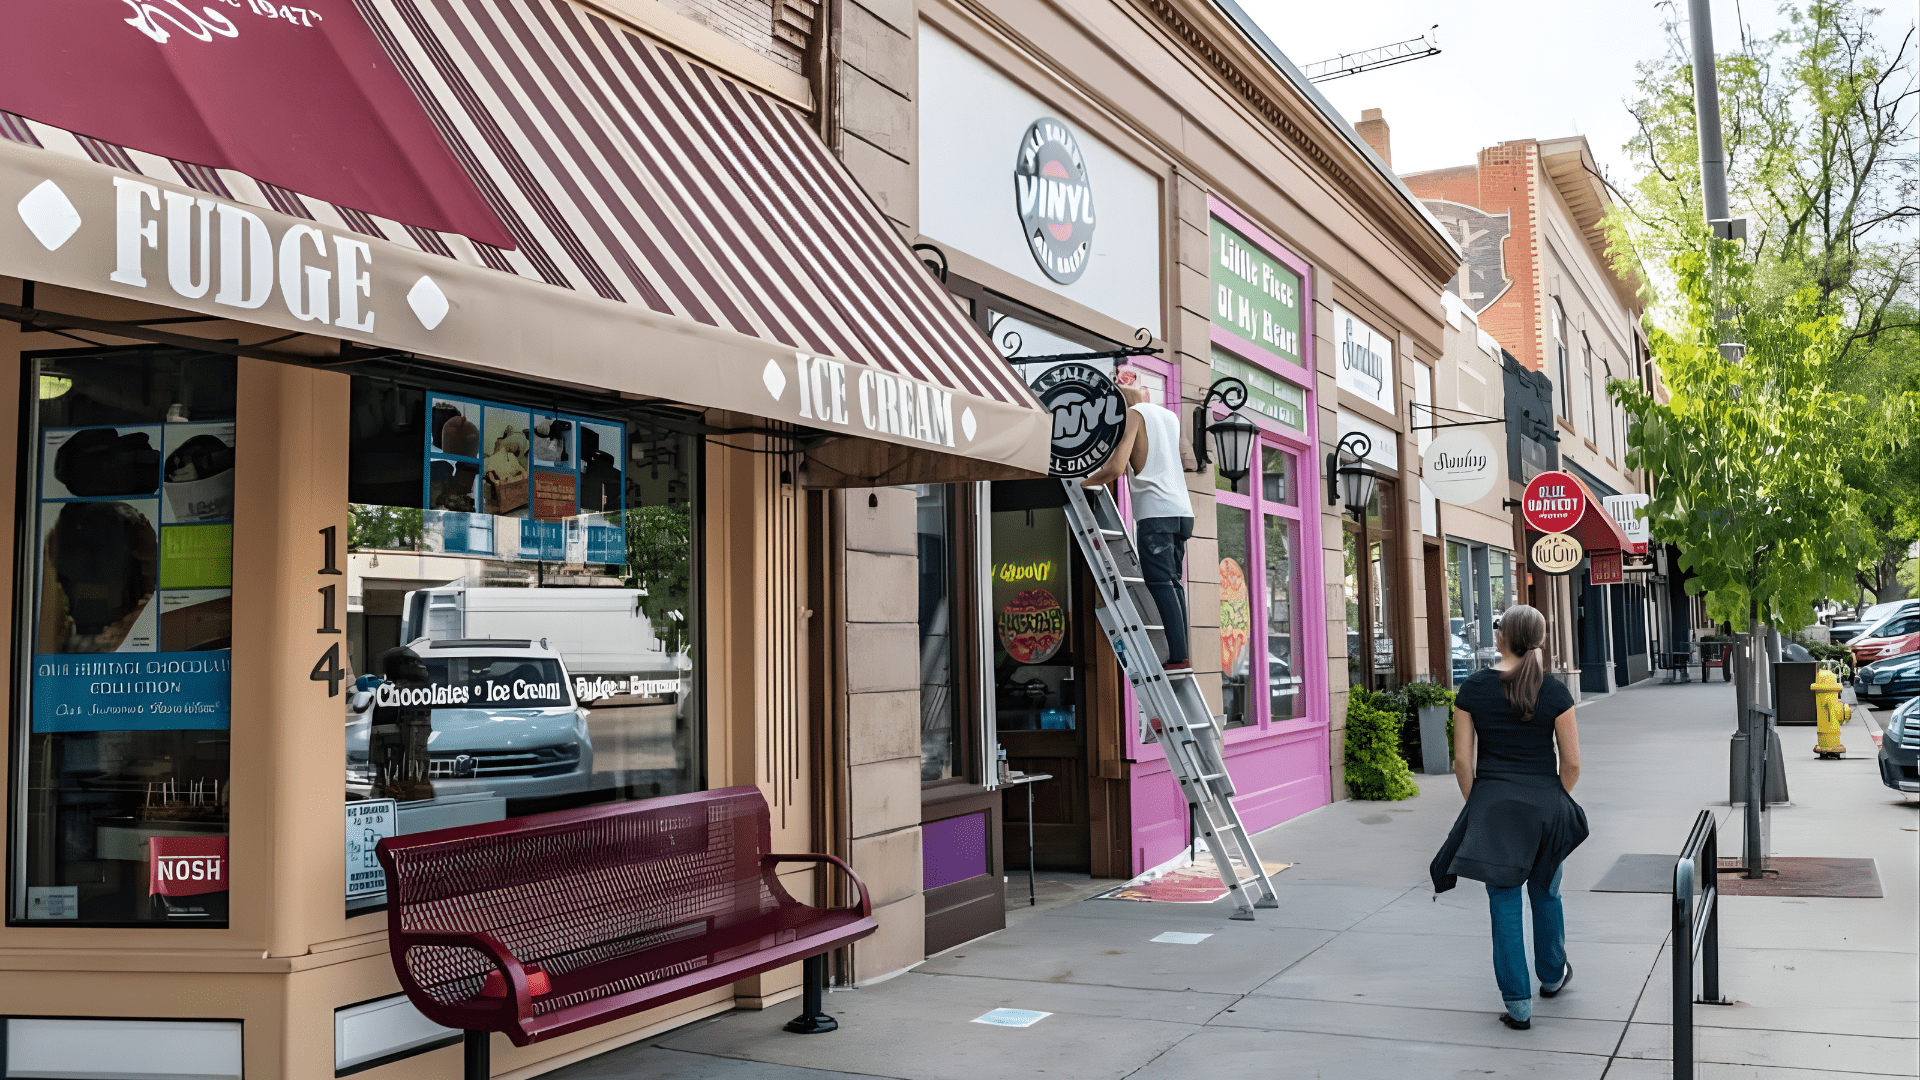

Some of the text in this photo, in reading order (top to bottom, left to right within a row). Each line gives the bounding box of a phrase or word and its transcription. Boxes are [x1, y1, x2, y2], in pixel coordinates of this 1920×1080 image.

[1017, 174, 1094, 225] VINYL
[110, 176, 375, 334] FUDGE
[796, 351, 956, 448] ICE CREAM
[1053, 394, 1125, 439] NYL
[310, 525, 345, 698] 114
[377, 682, 470, 708] Chocolates
[157, 859, 221, 881] NOSH
